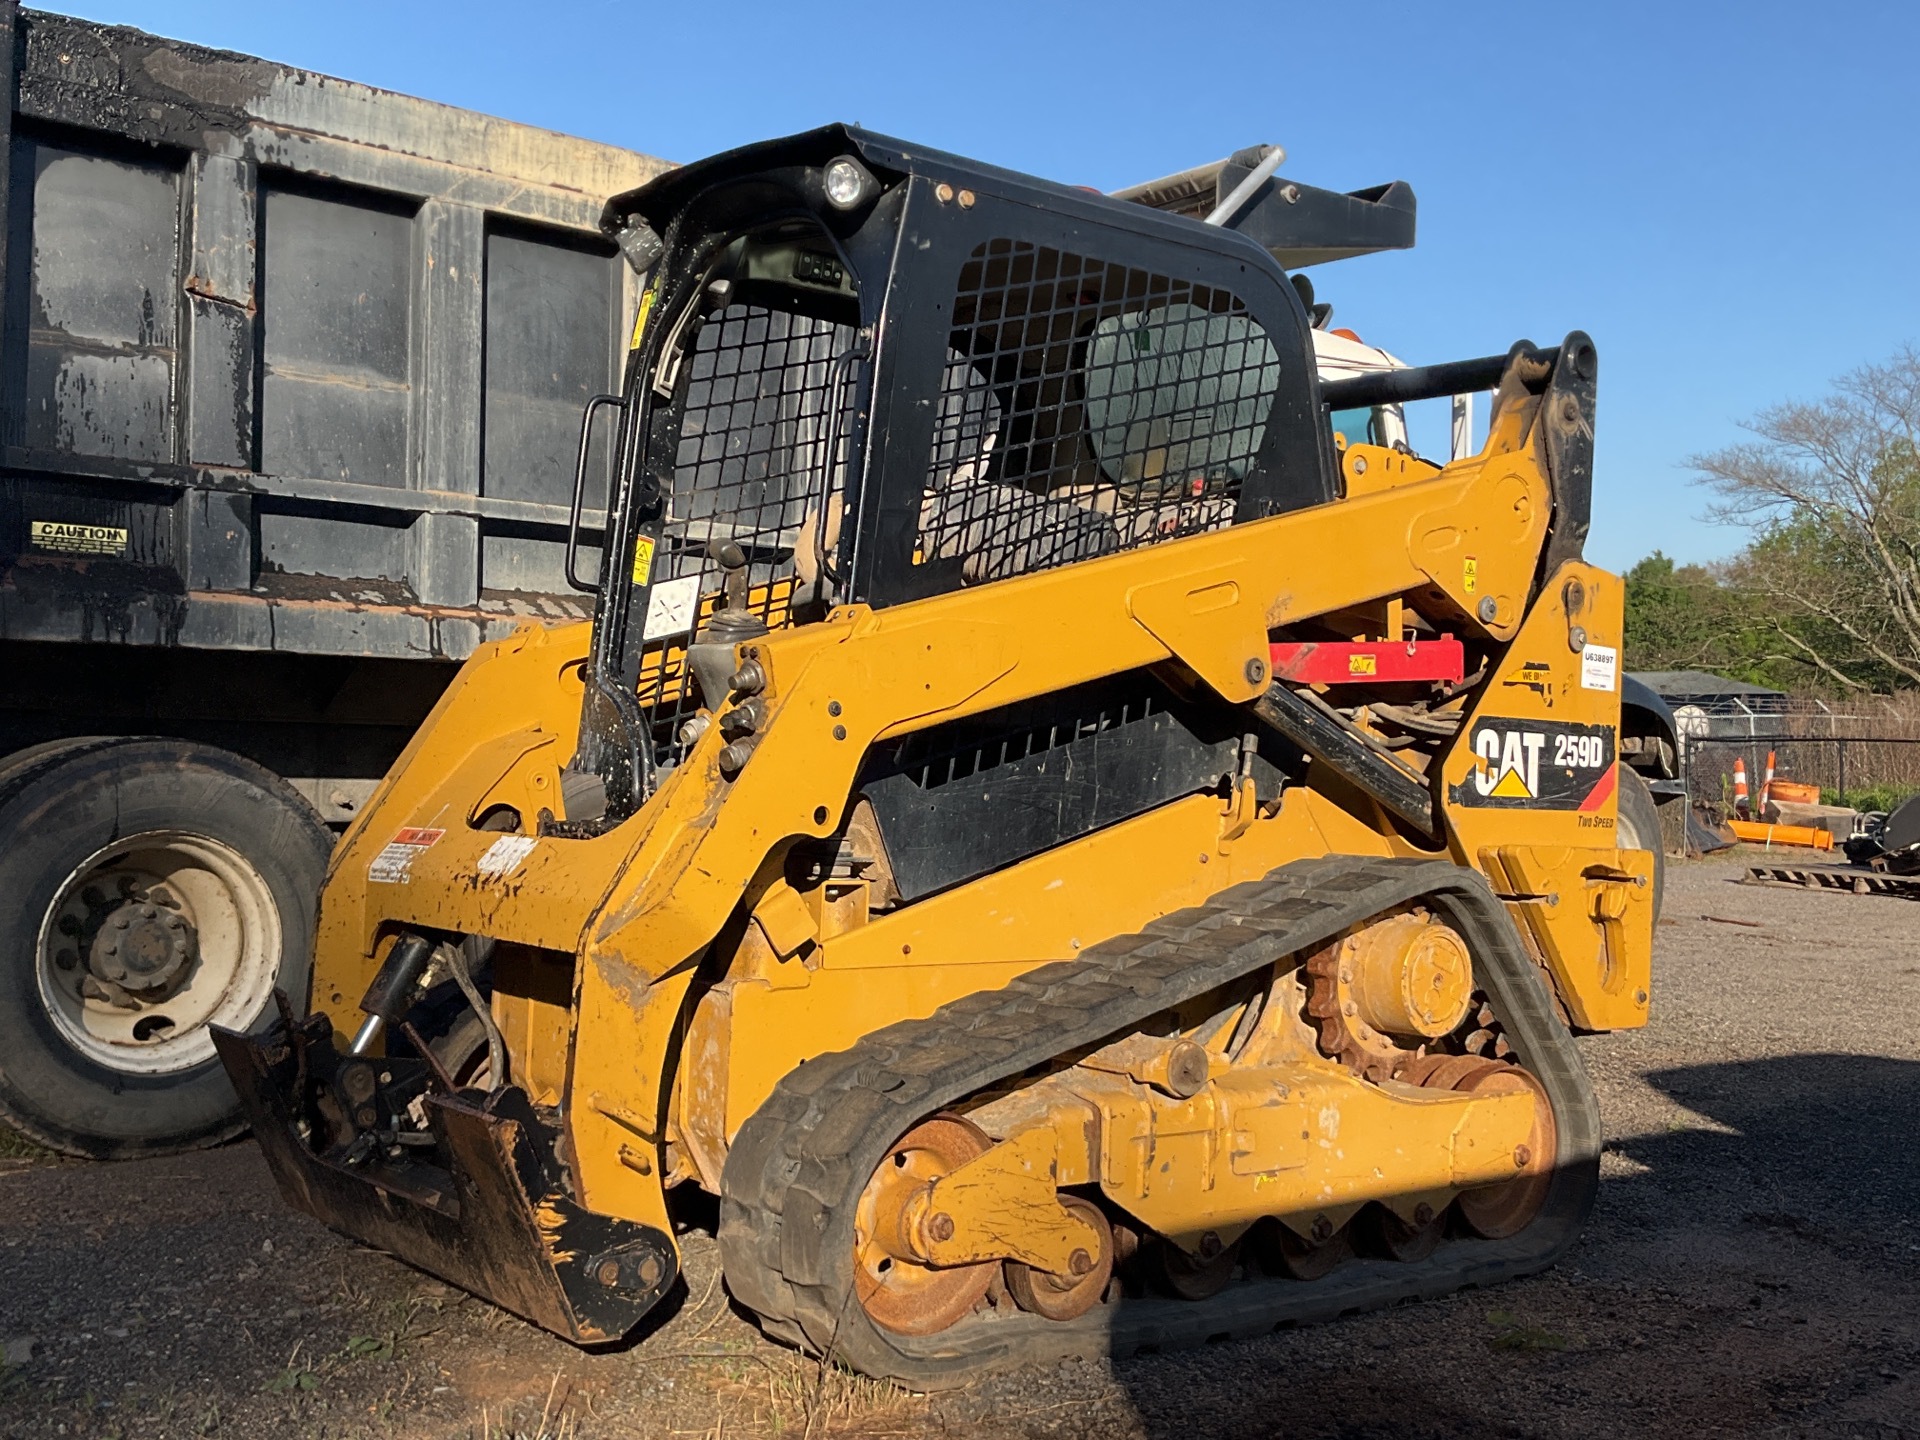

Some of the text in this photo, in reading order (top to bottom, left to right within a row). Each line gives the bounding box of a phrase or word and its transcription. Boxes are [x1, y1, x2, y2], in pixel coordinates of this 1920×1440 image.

[41, 523, 118, 541] CAUTION
[1585, 652, 1614, 664] U638897
[1475, 728, 1603, 798] CAT 259D
